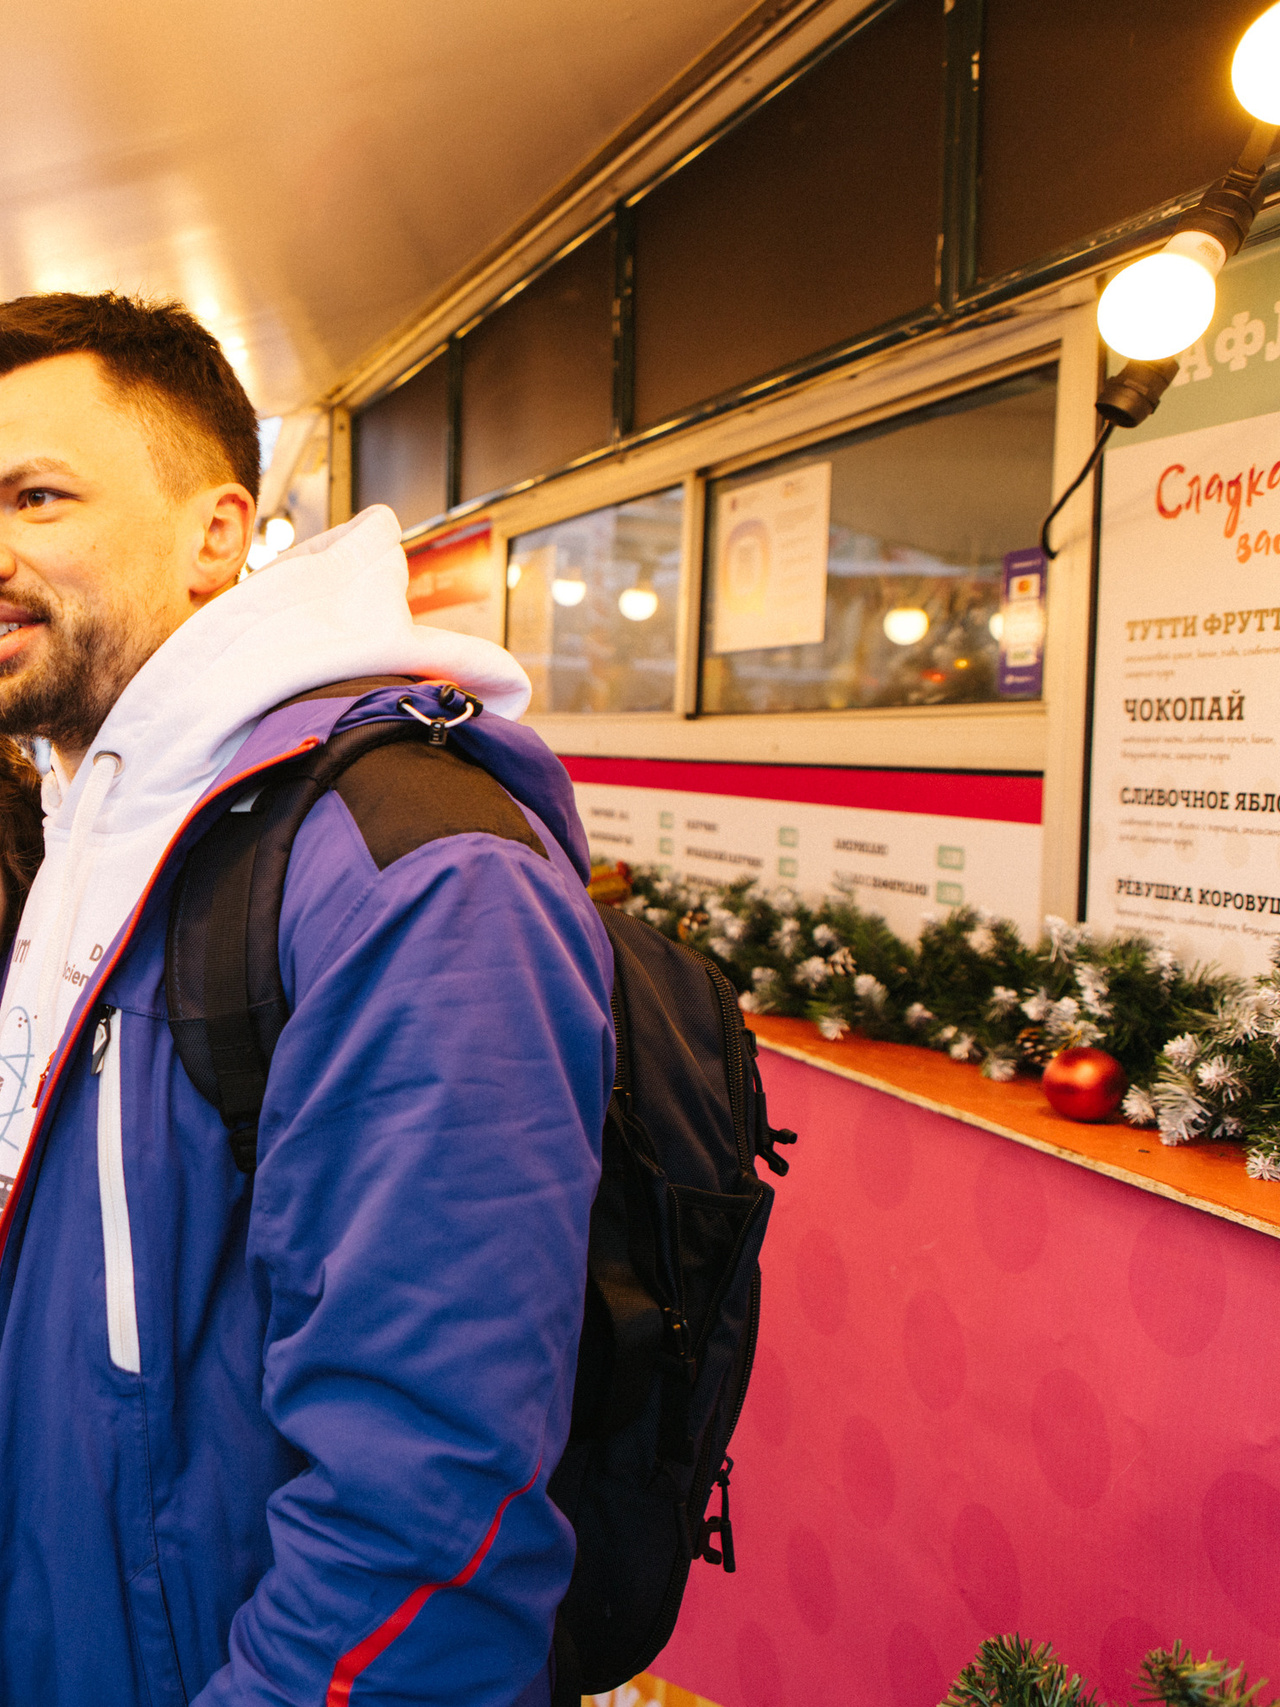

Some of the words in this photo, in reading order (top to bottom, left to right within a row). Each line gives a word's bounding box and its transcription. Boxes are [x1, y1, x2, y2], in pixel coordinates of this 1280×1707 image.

[1126, 615, 1198, 641] ТУТТИ
[1124, 689, 1245, 721] ЧОКОПАЙ
[1121, 787, 1230, 810] СЛИВОЧНОЕ
